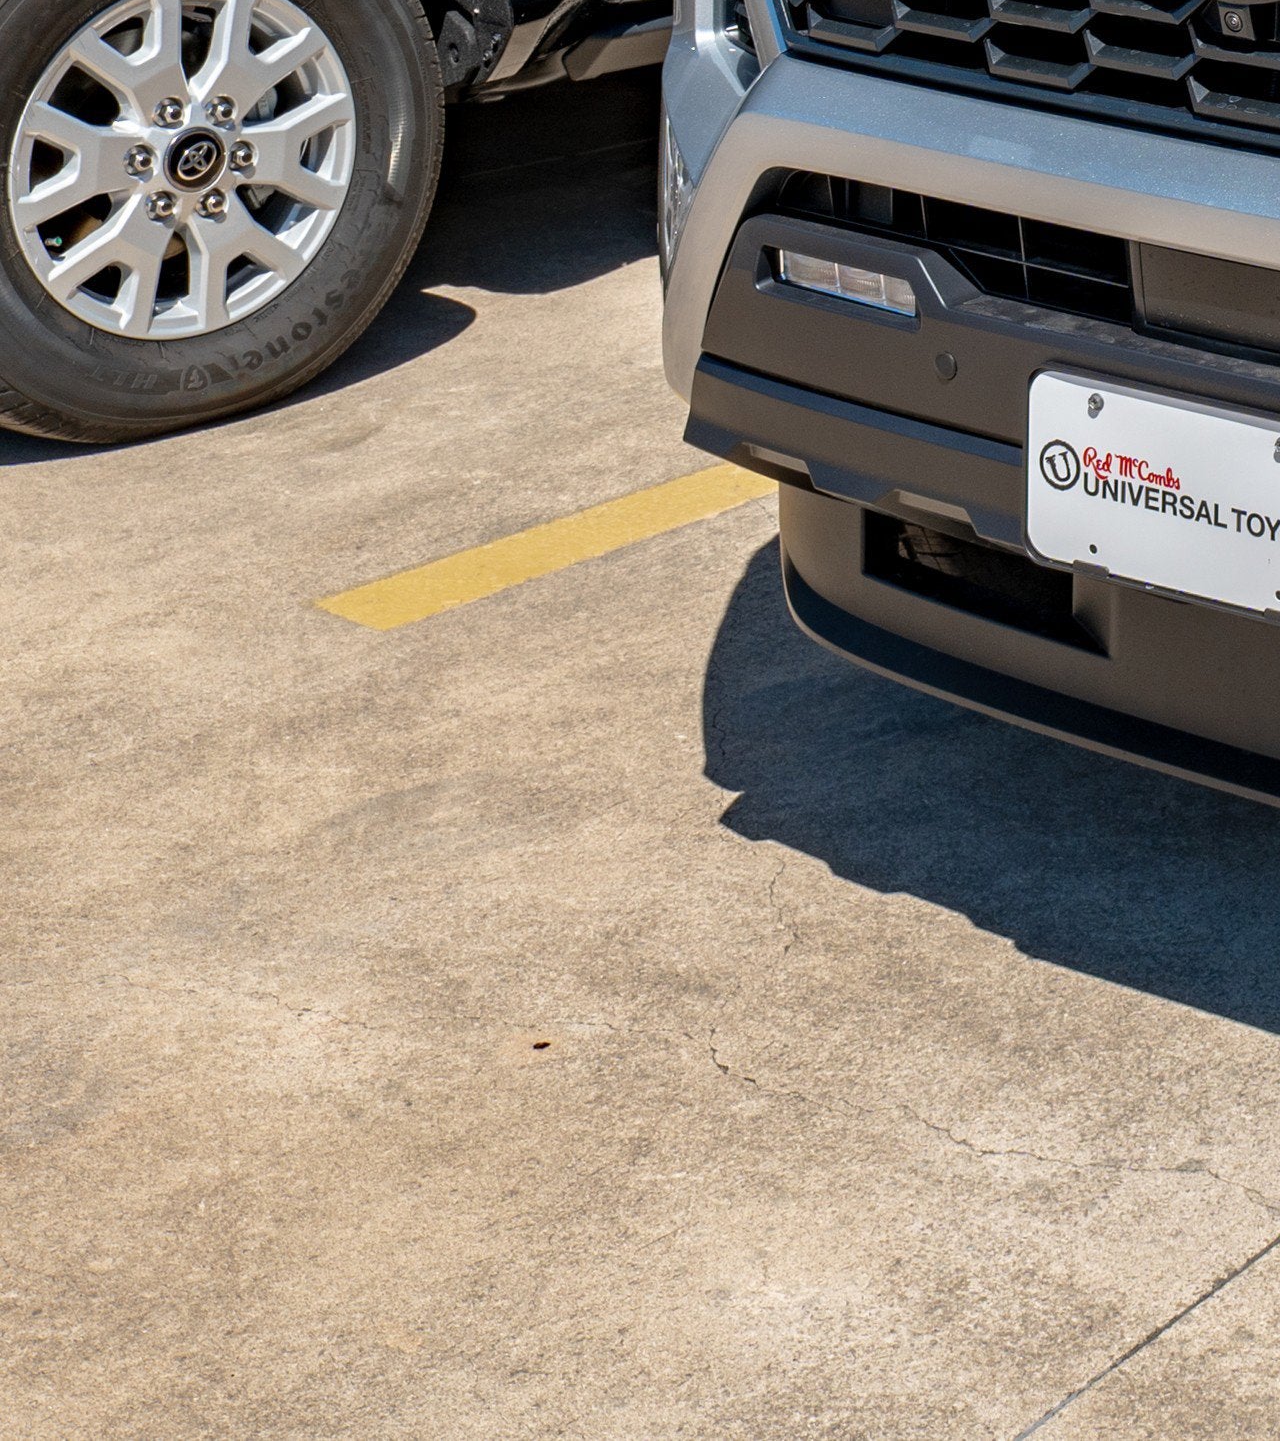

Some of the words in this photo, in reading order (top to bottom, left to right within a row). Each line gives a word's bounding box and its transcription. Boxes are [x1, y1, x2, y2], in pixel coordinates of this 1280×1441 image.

[1083, 446, 1113, 481] Red
[1114, 453, 1181, 491] McCombs
[1083, 472, 1228, 530] UNIVERSAL
